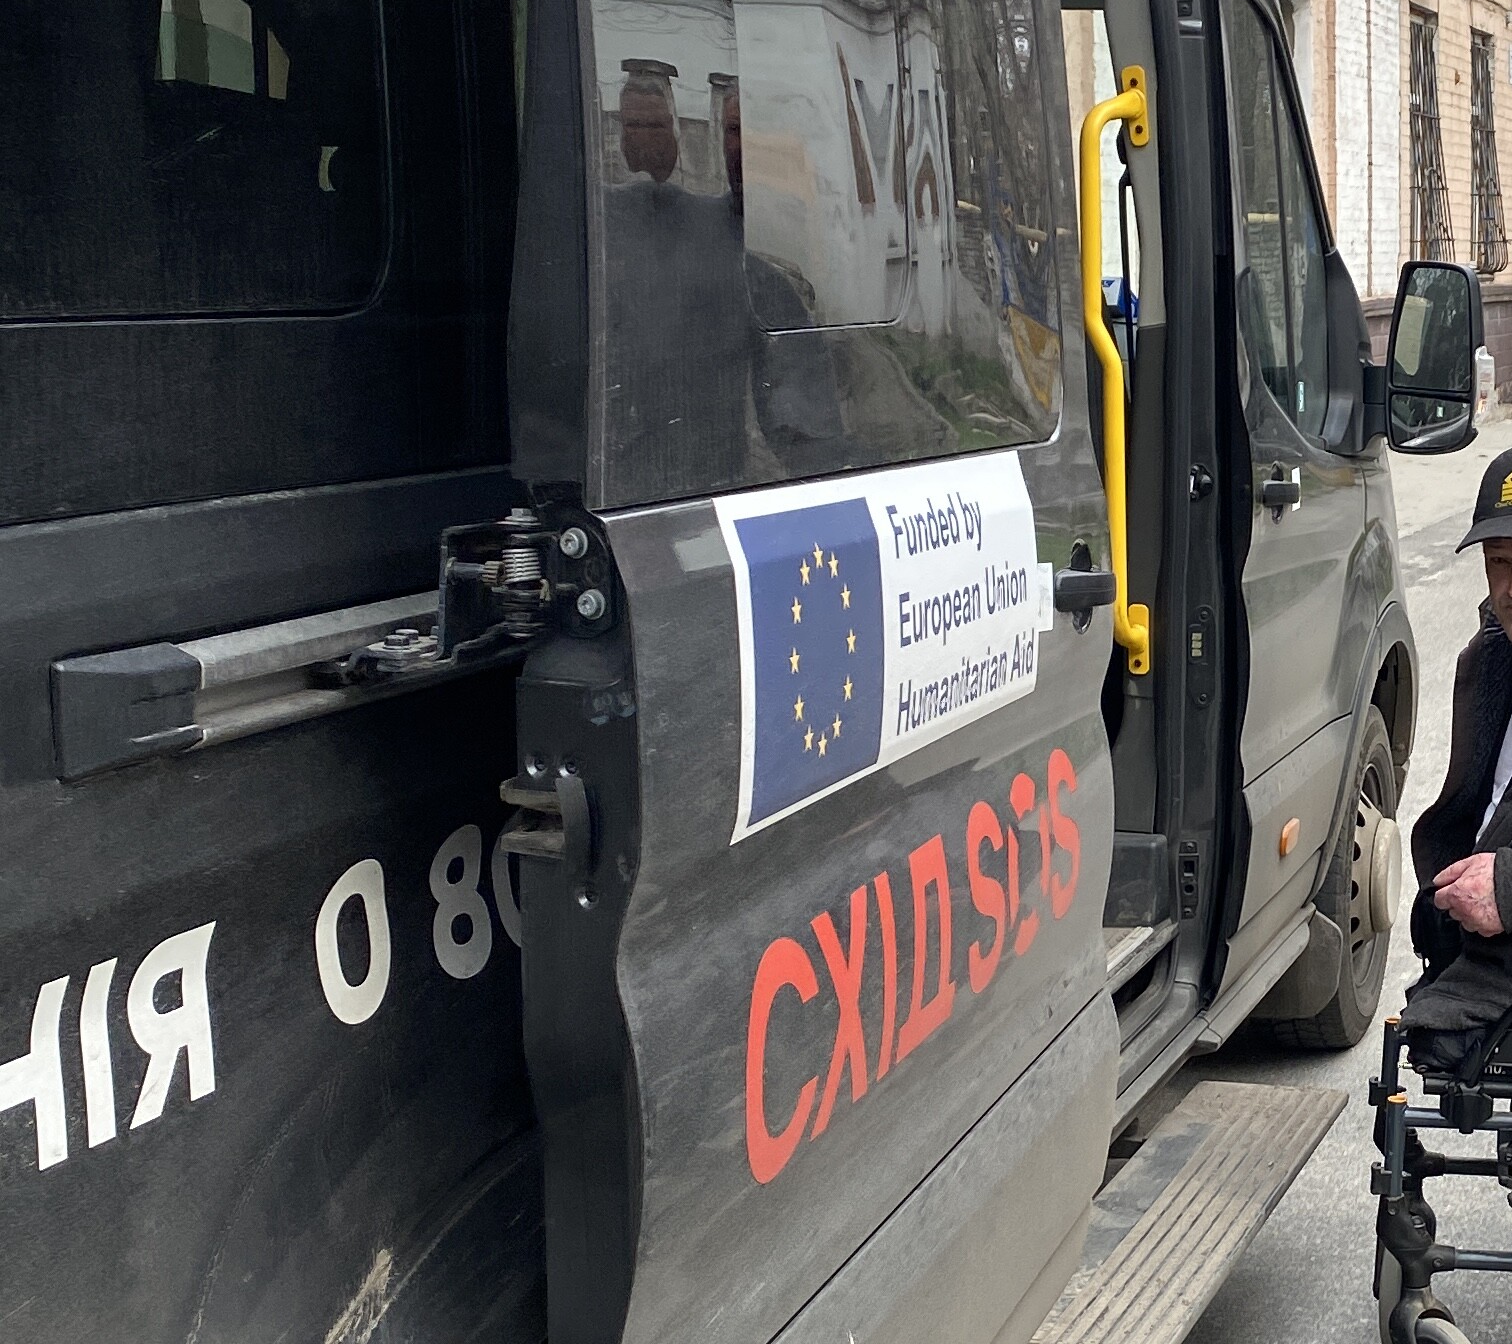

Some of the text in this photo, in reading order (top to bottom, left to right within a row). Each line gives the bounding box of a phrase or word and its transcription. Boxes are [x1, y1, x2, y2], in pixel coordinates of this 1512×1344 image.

[886, 491, 982, 559] Funded by
[899, 560, 1027, 648] European Union
[897, 627, 1035, 736] Humanitarian Aid
[315, 858, 391, 1025] 0
